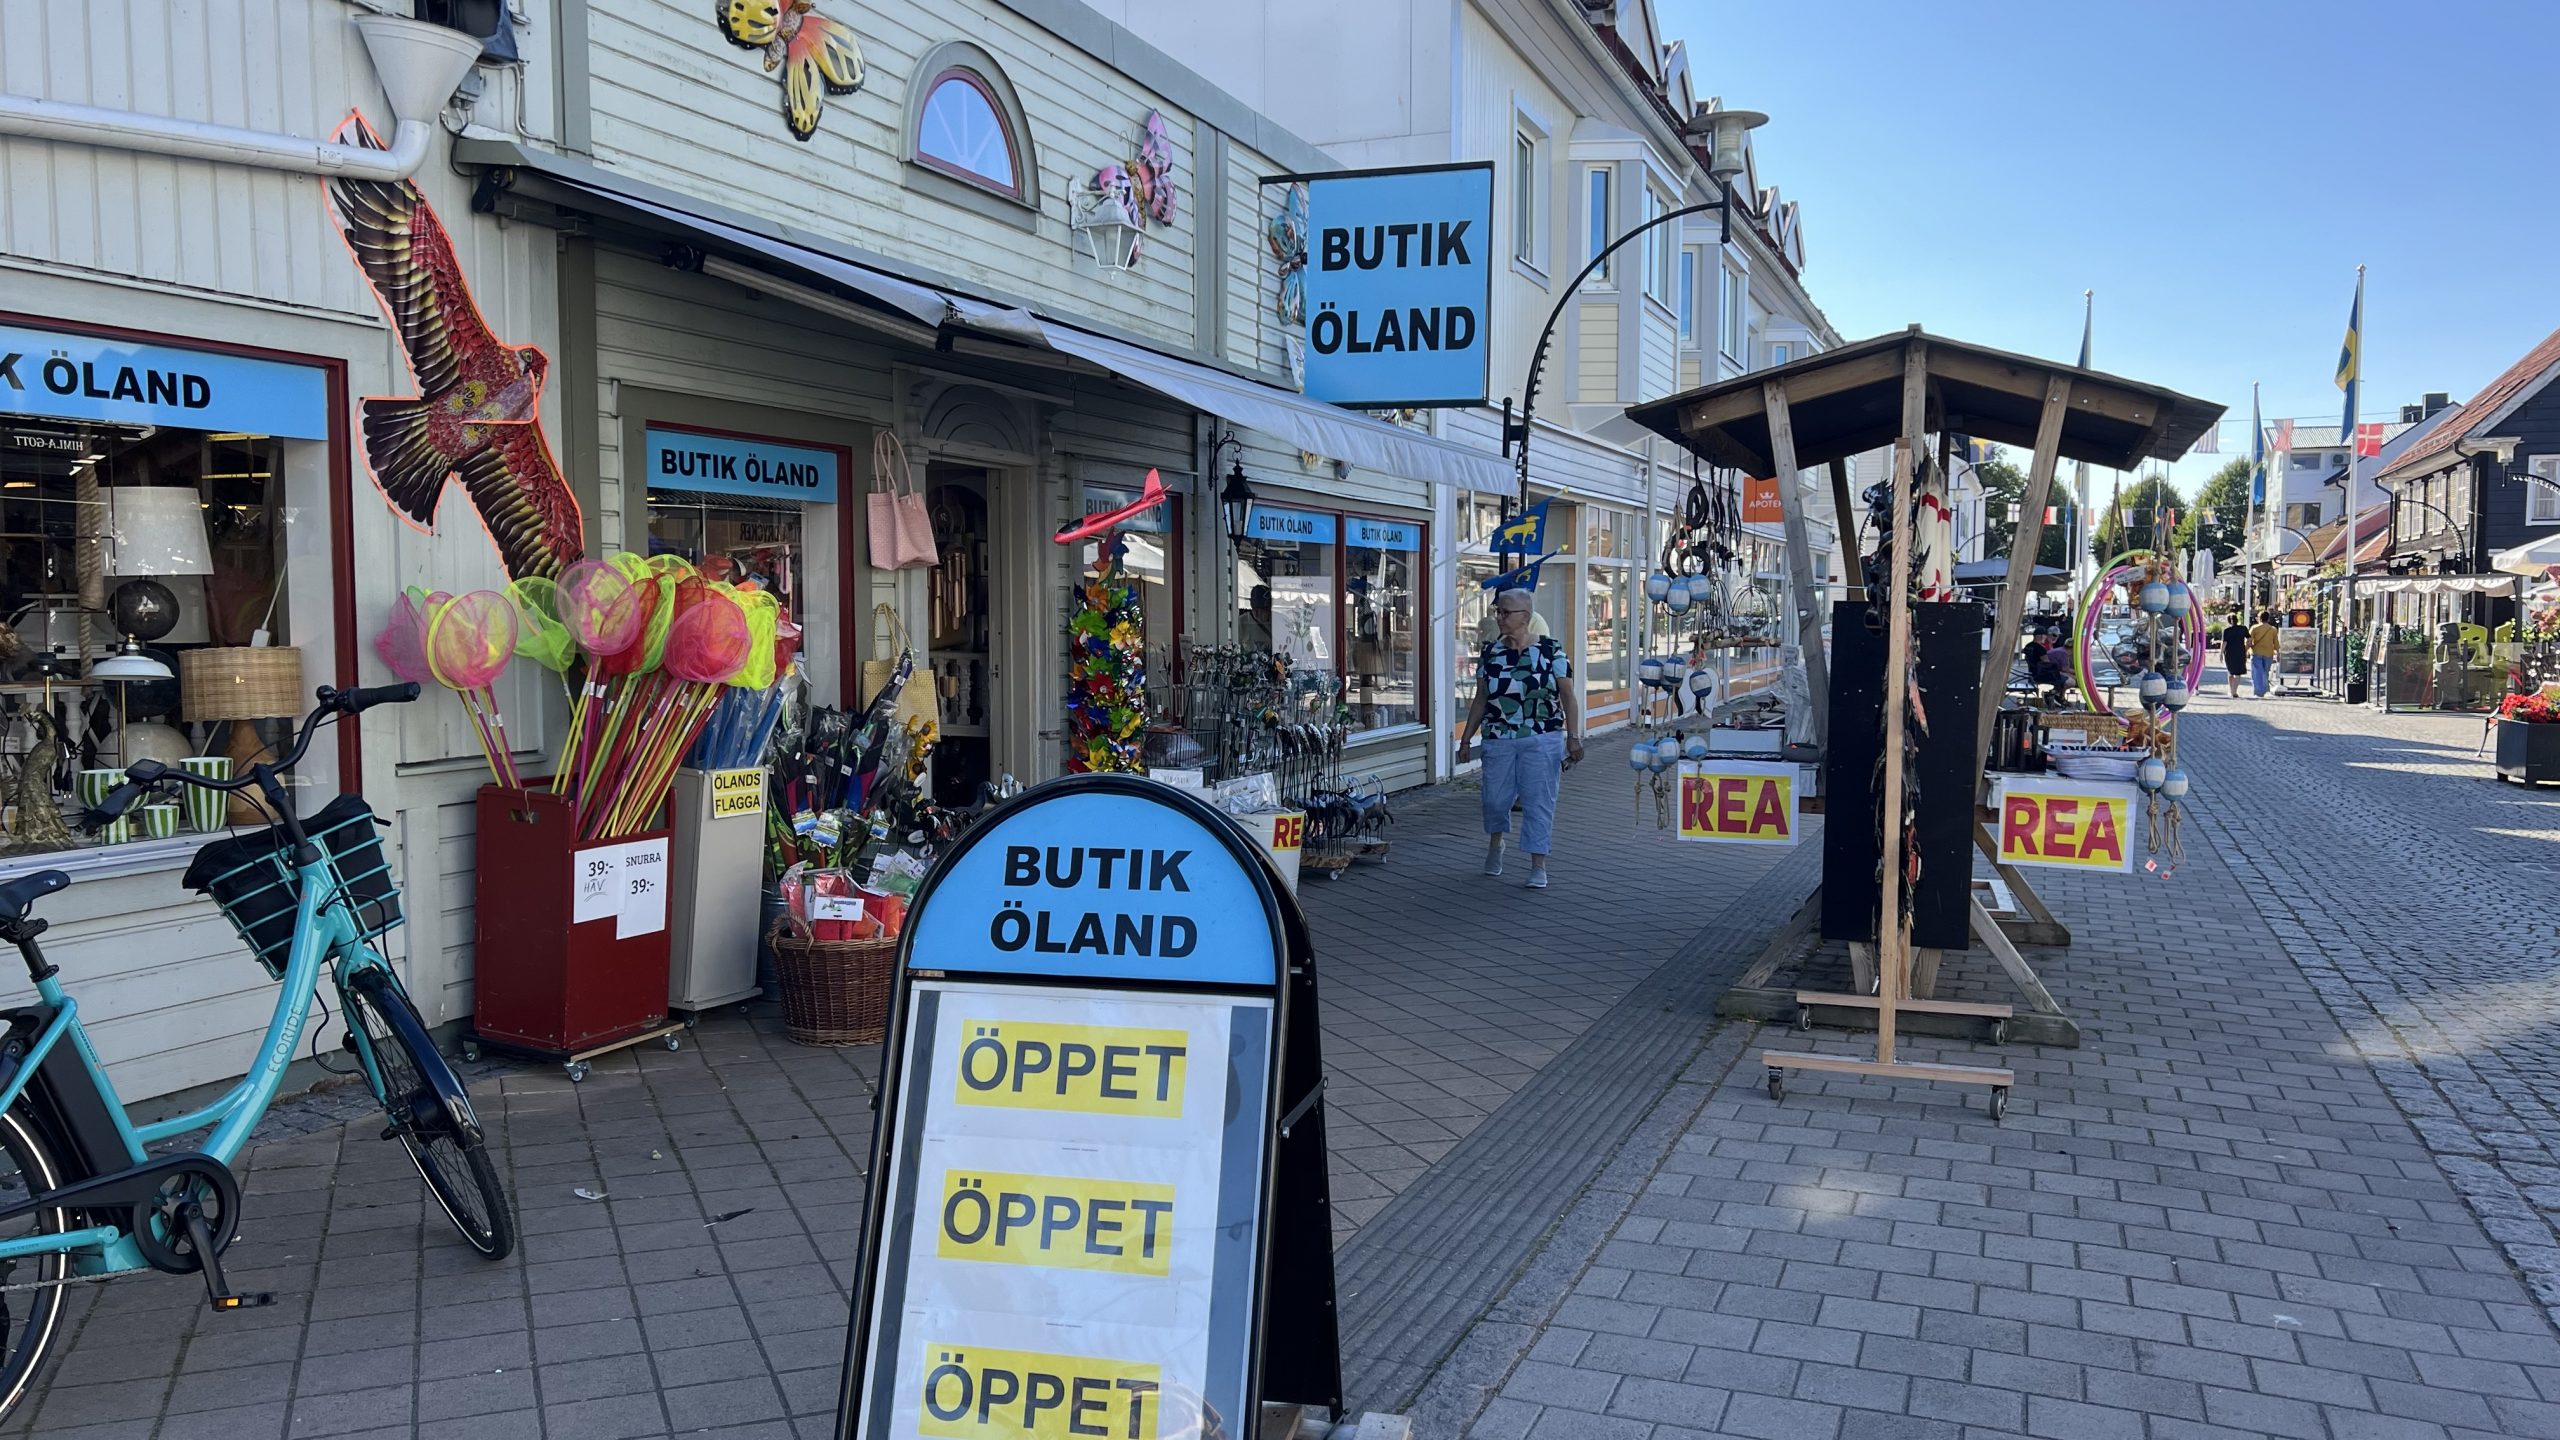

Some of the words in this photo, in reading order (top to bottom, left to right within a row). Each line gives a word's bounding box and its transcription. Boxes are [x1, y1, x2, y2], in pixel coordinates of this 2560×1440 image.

[1321, 220, 1472, 272] BUTIK
[1311, 301, 1476, 355] ÖLAND
[43, 349, 211, 409] ÖLAND
[661, 448, 737, 481] BUTIK
[744, 453, 819, 488] ÖLAND
[1259, 515, 1285, 533] BUTIK
[1287, 515, 1313, 535] ÖLAND
[1361, 527, 1381, 542] BUTIK
[1382, 528, 1403, 543] ÖLAND
[714, 773, 761, 790] ÖLANDS
[715, 794, 761, 812] FLAGGA
[1682, 776, 1789, 835] REA
[2003, 796, 2122, 862] REA
[588, 860, 614, 877] 39:-
[625, 852, 662, 868] SNURRA
[1004, 845, 1193, 892] BUTIK
[631, 878, 655, 895] 39:-
[990, 900, 1198, 958] ÖLAND
[267, 1008, 303, 1073] ECORIDE
[961, 1027, 1187, 1102] ÖPPET
[943, 1177, 1173, 1258] ÖPPET
[925, 1352, 1159, 1440] ÖPPET
